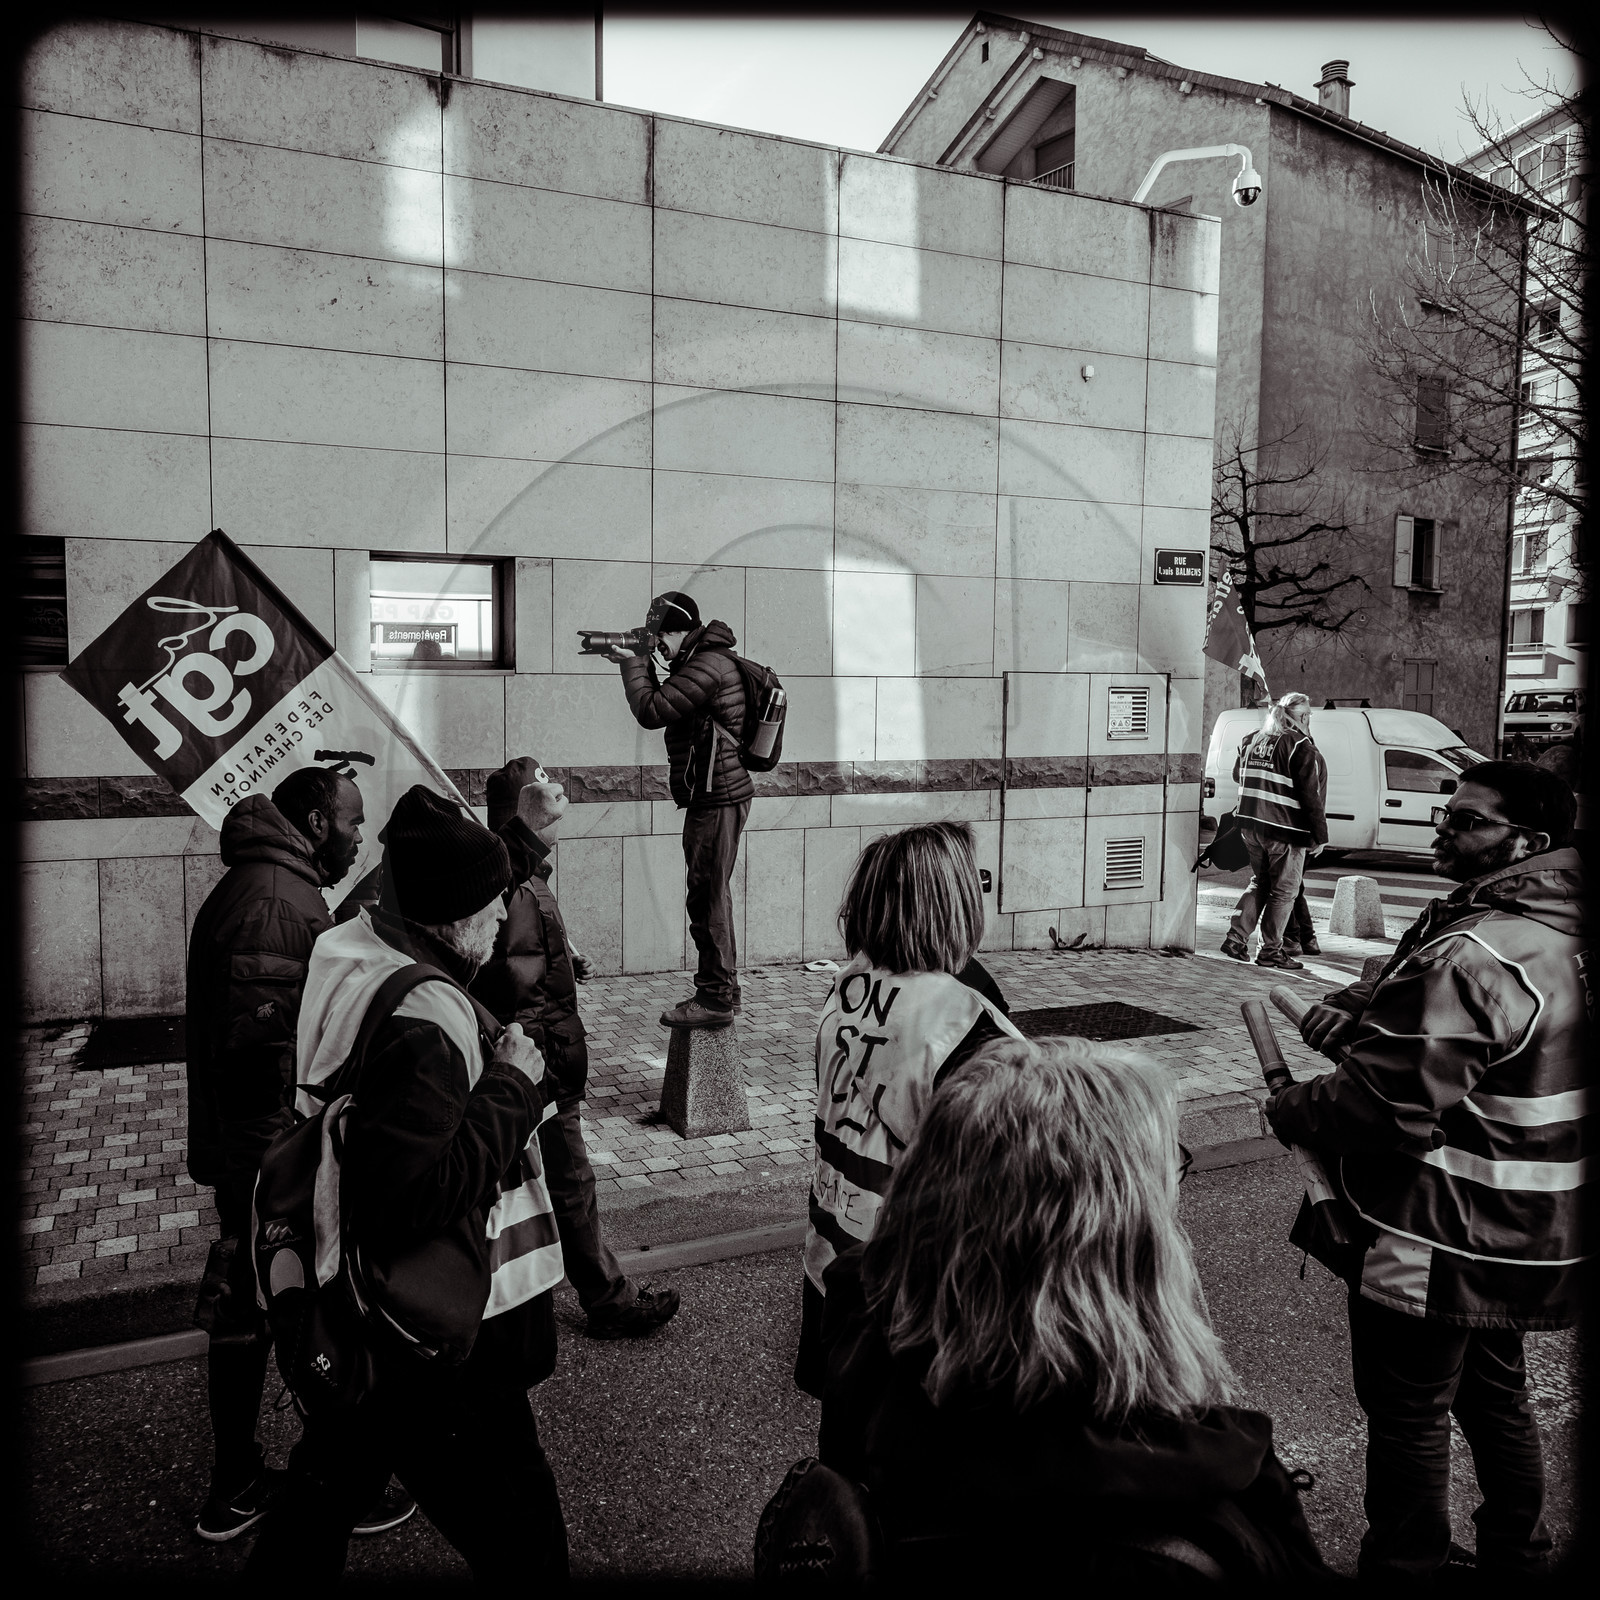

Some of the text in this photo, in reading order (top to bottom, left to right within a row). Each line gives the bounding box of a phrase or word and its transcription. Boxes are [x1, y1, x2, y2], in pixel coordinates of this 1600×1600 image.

[1173, 556, 1187, 566] RUE
[1158, 566, 1174, 576] Louis
[839, 973, 901, 1028] ON
